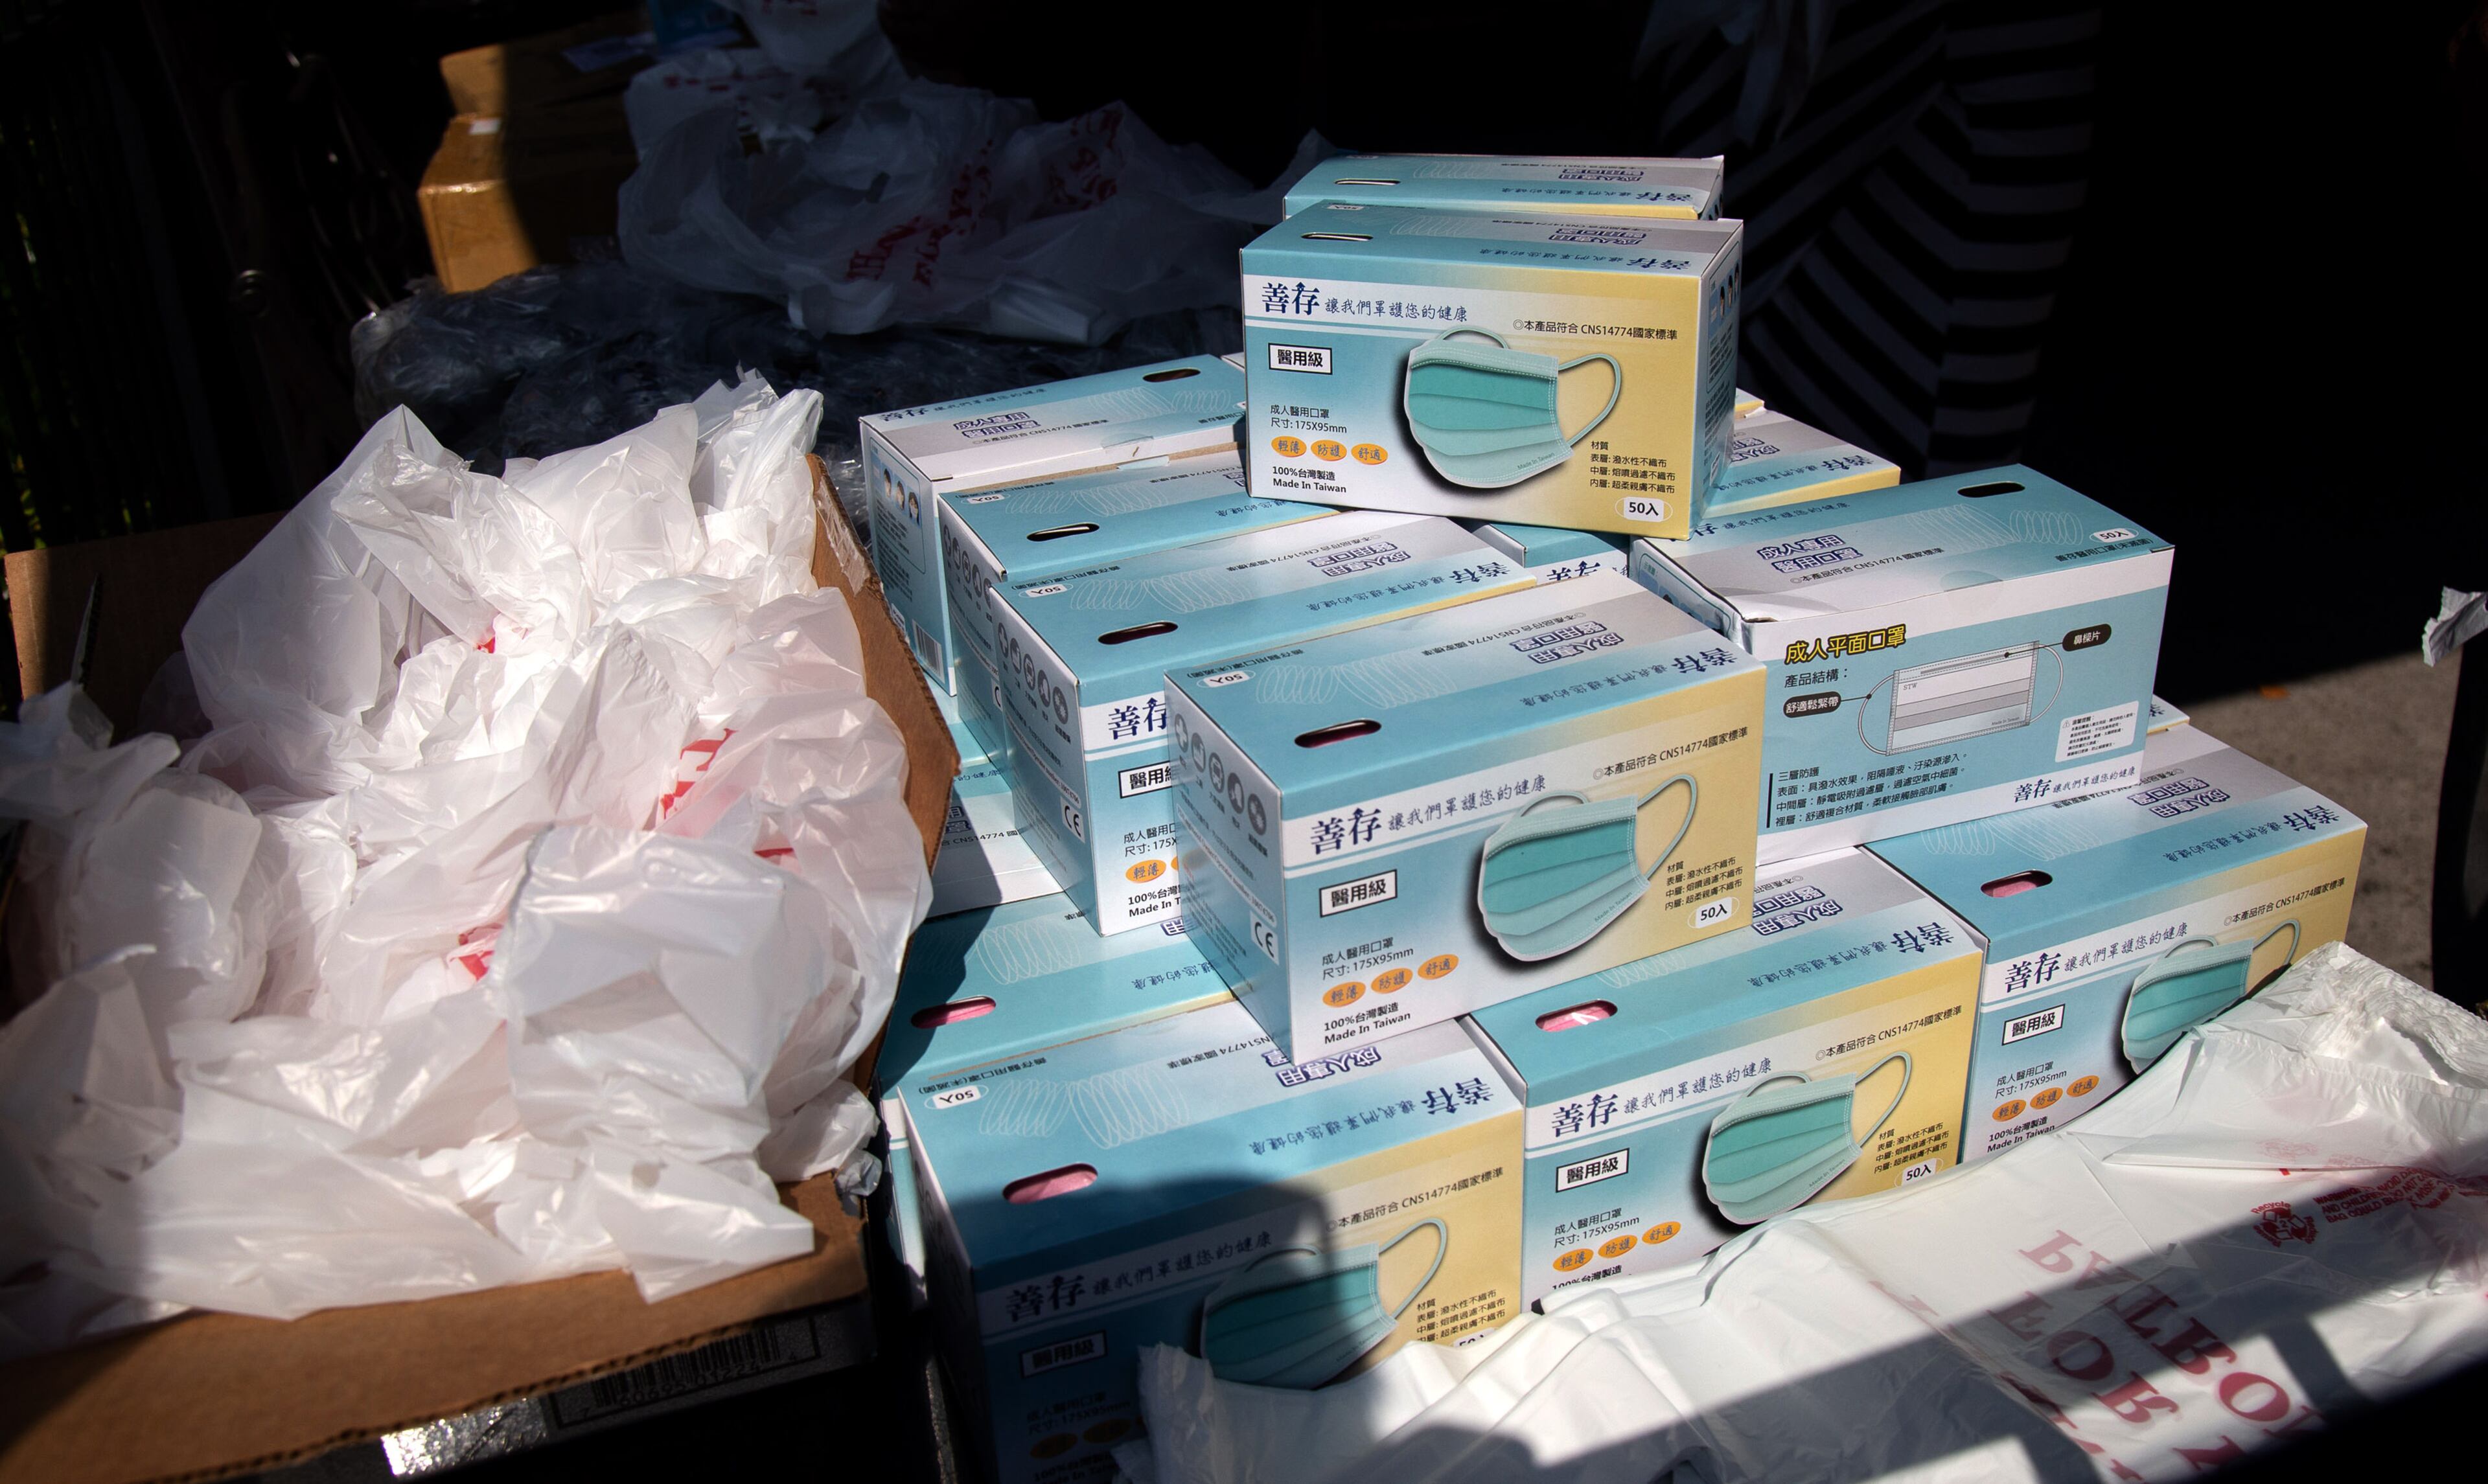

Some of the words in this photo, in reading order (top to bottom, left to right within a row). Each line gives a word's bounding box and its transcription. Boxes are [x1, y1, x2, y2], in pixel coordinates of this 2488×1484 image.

[1261, 282, 1320, 315] 善存
[1324, 298, 1468, 322] 讓我們罩護您的健康
[1513, 319, 1578, 334] ◎本產品符合
[1581, 324, 1677, 340] CNS14774國家標準
[1277, 349, 1323, 367] 醫用級
[1271, 405, 1330, 419] 成人醫用口罩
[1271, 417, 1293, 429] 尺寸:
[1295, 420, 1347, 433] 175X95mm
[1278, 440, 1300, 454] 輕薄
[1317, 444, 1341, 457] 防護
[1357, 448, 1382, 461] 舒適
[1591, 440, 1609, 451] 材質
[1272, 466, 1336, 481] 100%台灣製造
[1590, 466, 1611, 476] 中層:
[1611, 467, 1676, 481] 熔噴過濾不織布
[1591, 453, 1611, 463] 表層:
[1612, 455, 1667, 468] 潑水性不織布
[1273, 478, 1299, 488] Made
[1302, 481, 1311, 490] In
[1313, 482, 1347, 493] Taiwan
[1611, 479, 1675, 494] 超柔親膚不織布
[1629, 502, 1659, 516] 50入
[1757, 534, 1846, 560] 成人專用
[2099, 530, 2129, 540] 50入
[1307, 541, 1398, 567] 醫用口罩
[1321, 550, 1412, 576] 成人專用
[1771, 547, 1864, 573] 醫用口罩
[1854, 555, 1903, 571] CNS14774
[1447, 560, 1512, 585] 善存
[1031, 586, 1061, 595] 50入
[1468, 628, 1519, 646] CNS14774
[1509, 620, 1607, 651] 醫用口罩
[1527, 632, 1624, 664] 成人專用
[1784, 623, 1906, 665] 成人平面口罩
[1670, 646, 1738, 674] 善存
[1210, 674, 1243, 684] 50入
[1784, 667, 1847, 688] 產品結構：
[1786, 696, 1839, 714] 舒適鬆緊帶
[1593, 753, 1657, 780] ◎本產品符合
[1660, 726, 1748, 761] CNS14774國家標準
[1778, 766, 1819, 782] 三層防護
[2014, 779, 2052, 803] 善存
[2126, 777, 2209, 806] 醫用口罩
[2148, 788, 2231, 818] 成人專用
[1311, 806, 1382, 855] 善存
[1388, 773, 1546, 830] 讓我們罩護您的健康
[2283, 805, 2342, 832] 善存
[952, 832, 1004, 845] CNS14774
[1124, 842, 1151, 857] 尺寸:
[1133, 862, 1160, 880] 輕薄
[1666, 861, 1684, 874] 材質
[1666, 874, 1686, 887] 表層:
[1687, 856, 1736, 880] 潑水性不織布
[1330, 878, 1387, 908] 醫用級
[1665, 885, 1685, 898] 中層:
[1686, 867, 1744, 893] 熔噴過濾不織布
[1685, 878, 1743, 906] 超柔親膚不織布
[1129, 904, 1158, 919] Made
[1161, 900, 1172, 909] In
[1700, 904, 1728, 921] 50入
[2224, 902, 2274, 926] ◎本產品符合
[2275, 876, 2345, 909] CNS14774國家標準
[1751, 899, 1843, 936] 成人專用
[1891, 921, 1954, 953] 善存
[1322, 937, 1394, 966] 成人醫用口罩
[1322, 965, 1350, 980] 尺寸:
[1353, 948, 1414, 972] 175X95mm
[1747, 940, 1888, 988] 讓我們罩護您的健康
[2004, 952, 2062, 994] 善存
[2064, 921, 2188, 972] 讓我們罩護您的健康
[1379, 970, 1406, 990] 防護
[1425, 958, 1452, 976] 舒適
[1331, 985, 1358, 1004] 輕薄
[1324, 1002, 1399, 1031] 100%台灣製造
[1324, 1030, 1356, 1044] Made
[1359, 1025, 1370, 1034] In
[1373, 1012, 1411, 1029] Taiwan
[2012, 1011, 2055, 1037] 醫用級
[1815, 1033, 1876, 1061] ◎本產品符合
[1878, 1005, 1963, 1041] CNS14774國家標準
[1276, 1046, 1382, 1088] 成人專用
[1996, 1061, 2054, 1087] 成人醫用口罩
[939, 1090, 974, 1104] 50入
[1422, 1077, 1495, 1115] 善存
[1551, 1093, 1618, 1137] 善存
[1624, 1057, 1771, 1115] 讓我們罩護您的健康
[1995, 1086, 2017, 1099] 尺寸:
[2019, 1070, 2067, 1091] 175X95mm
[2073, 1078, 2093, 1093] 舒適
[1999, 1102, 2020, 1118] 輕薄
[2036, 1090, 2058, 1106] 防護
[1249, 1099, 1416, 1156] 讓我們罩護您的健康
[1877, 1139, 1895, 1152] 表層:
[1896, 1122, 1944, 1145] 潑水性不織布
[1879, 1128, 1895, 1141] 材質
[1987, 1139, 2012, 1153] Made
[2014, 1135, 2023, 1143] In
[2025, 1124, 2055, 1139] Taiwan
[1988, 1116, 2047, 1142] 100%台灣製造
[1875, 1150, 1894, 1163] 中層:
[1895, 1130, 1950, 1156] 熔噴過濾不織布
[1893, 1141, 1948, 1167] 超柔親膚不織布
[1567, 1157, 1619, 1184] 醫用級
[1906, 1163, 1932, 1181] 50入
[1401, 1166, 1503, 1209] CNS14774國家標準
[2250, 1200, 2291, 1215] Recycle
[2321, 1203, 2341, 1215] AND
[2325, 1212, 2349, 1223] BAG
[1554, 1207, 1622, 1236] 成人醫用口罩
[1554, 1234, 1580, 1248] 尺寸:
[1582, 1216, 1639, 1240] 175X95mm
[1648, 1225, 1674, 1241] 舒適
[1605, 1237, 1631, 1255] 防護
[1560, 1251, 1586, 1269] 輕薄
[1006, 1274, 1085, 1323] 善存
[1092, 1230, 1271, 1296] 讓我們罩護您的健康
[1416, 1298, 1436, 1312] 材質
[1416, 1310, 1438, 1323] 表層:
[1440, 1289, 1497, 1316] 潑水性不織布
[1416, 1322, 1438, 1334] 中層:
[1440, 1297, 1506, 1327] 熔噴過濾不織布
[1440, 1309, 1506, 1338] 超柔親膚不織布
